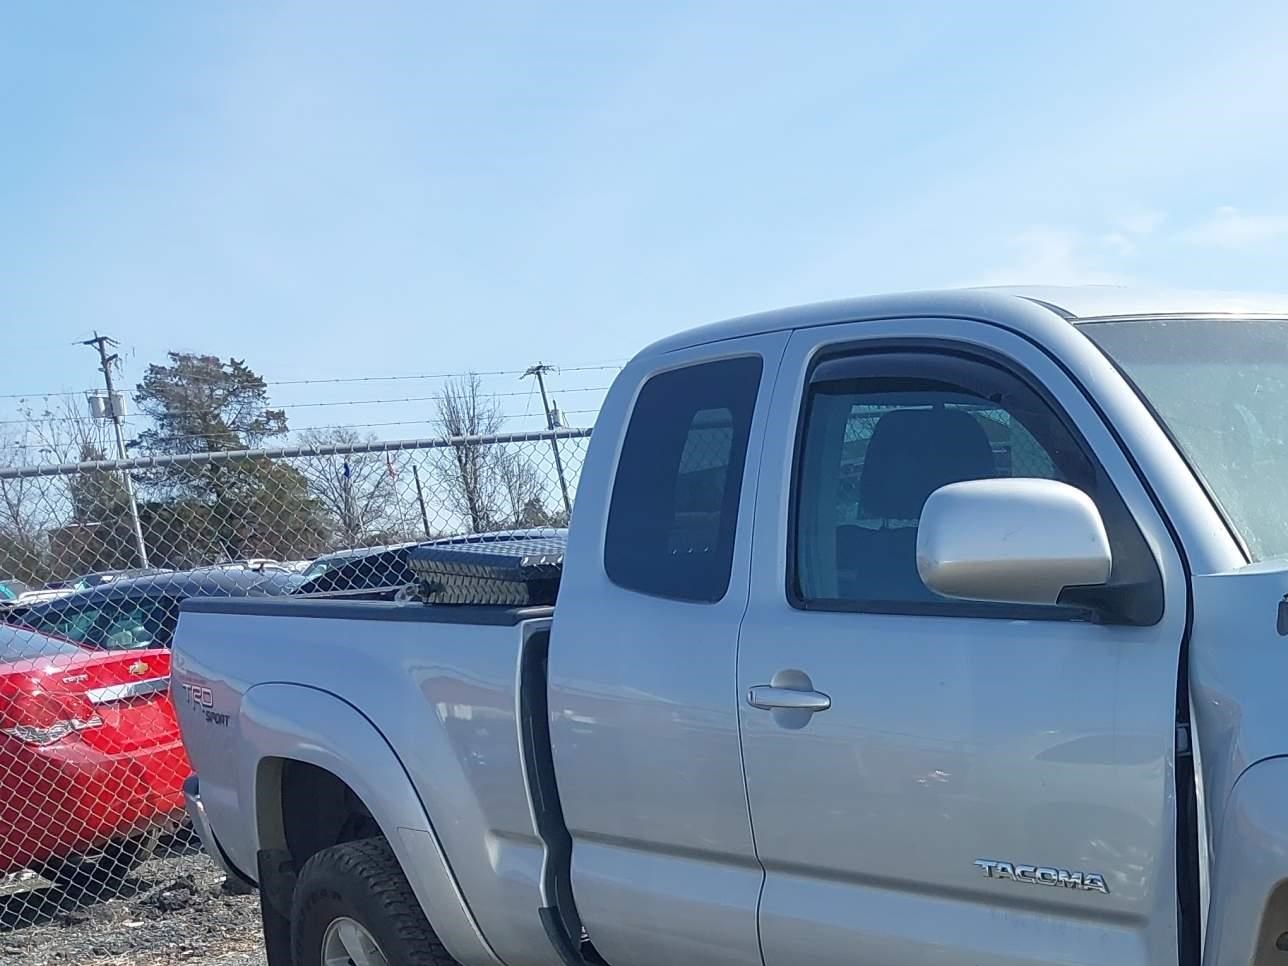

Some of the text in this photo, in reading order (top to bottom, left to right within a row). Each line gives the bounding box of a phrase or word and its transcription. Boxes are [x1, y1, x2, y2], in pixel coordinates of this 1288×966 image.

[182, 683, 213, 711] TRD
[205, 710, 230, 727] SPORT
[974, 858, 1111, 894] TACOMA
